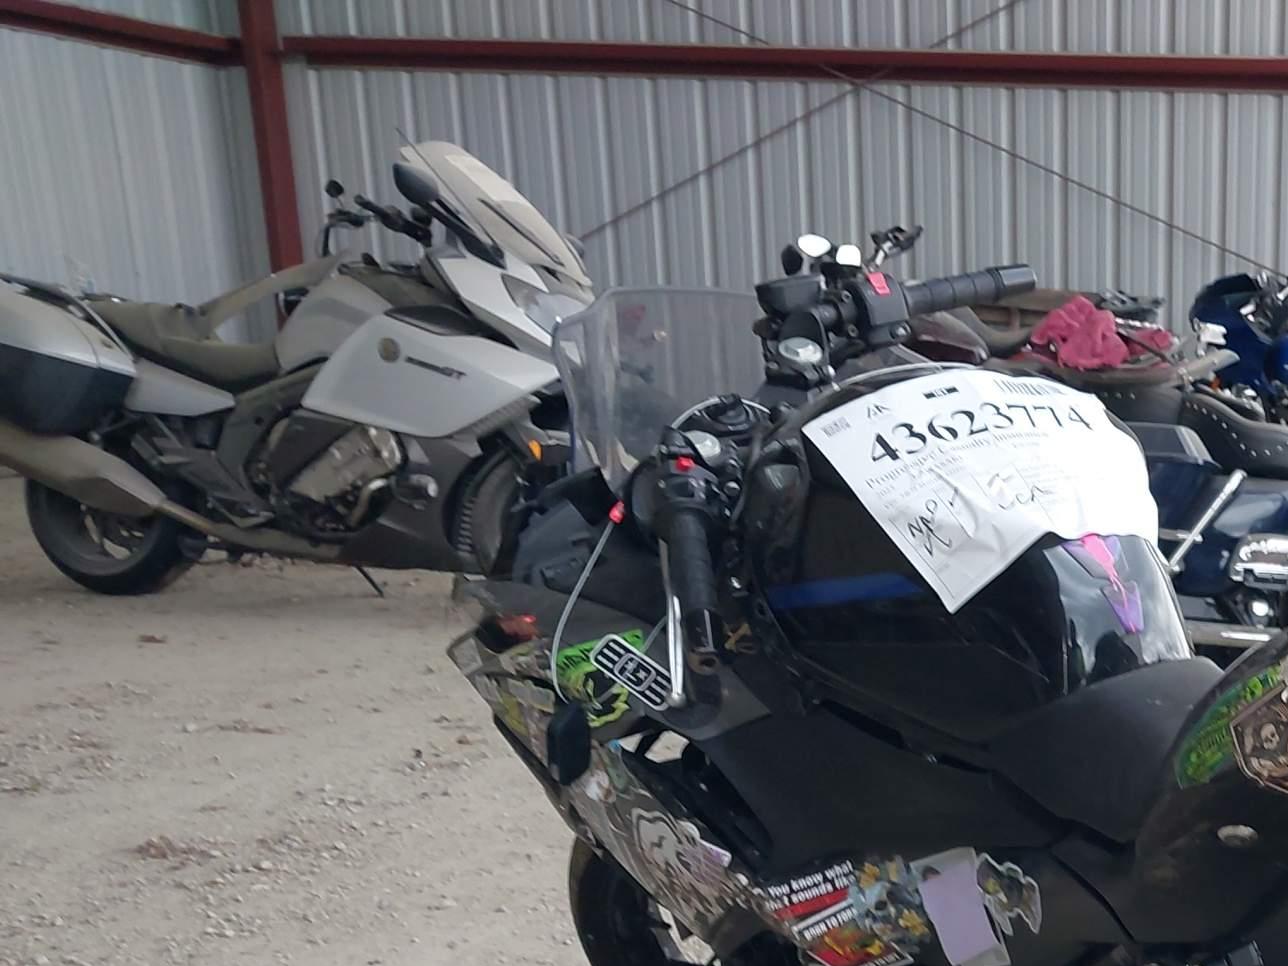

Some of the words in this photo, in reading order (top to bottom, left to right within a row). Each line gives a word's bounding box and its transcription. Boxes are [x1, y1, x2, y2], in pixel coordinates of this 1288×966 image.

[870, 402, 1093, 462] 43623774
[767, 884, 791, 898] You
[790, 871, 824, 891] know
[825, 859, 855, 881] what
[791, 882, 834, 904] sounds
